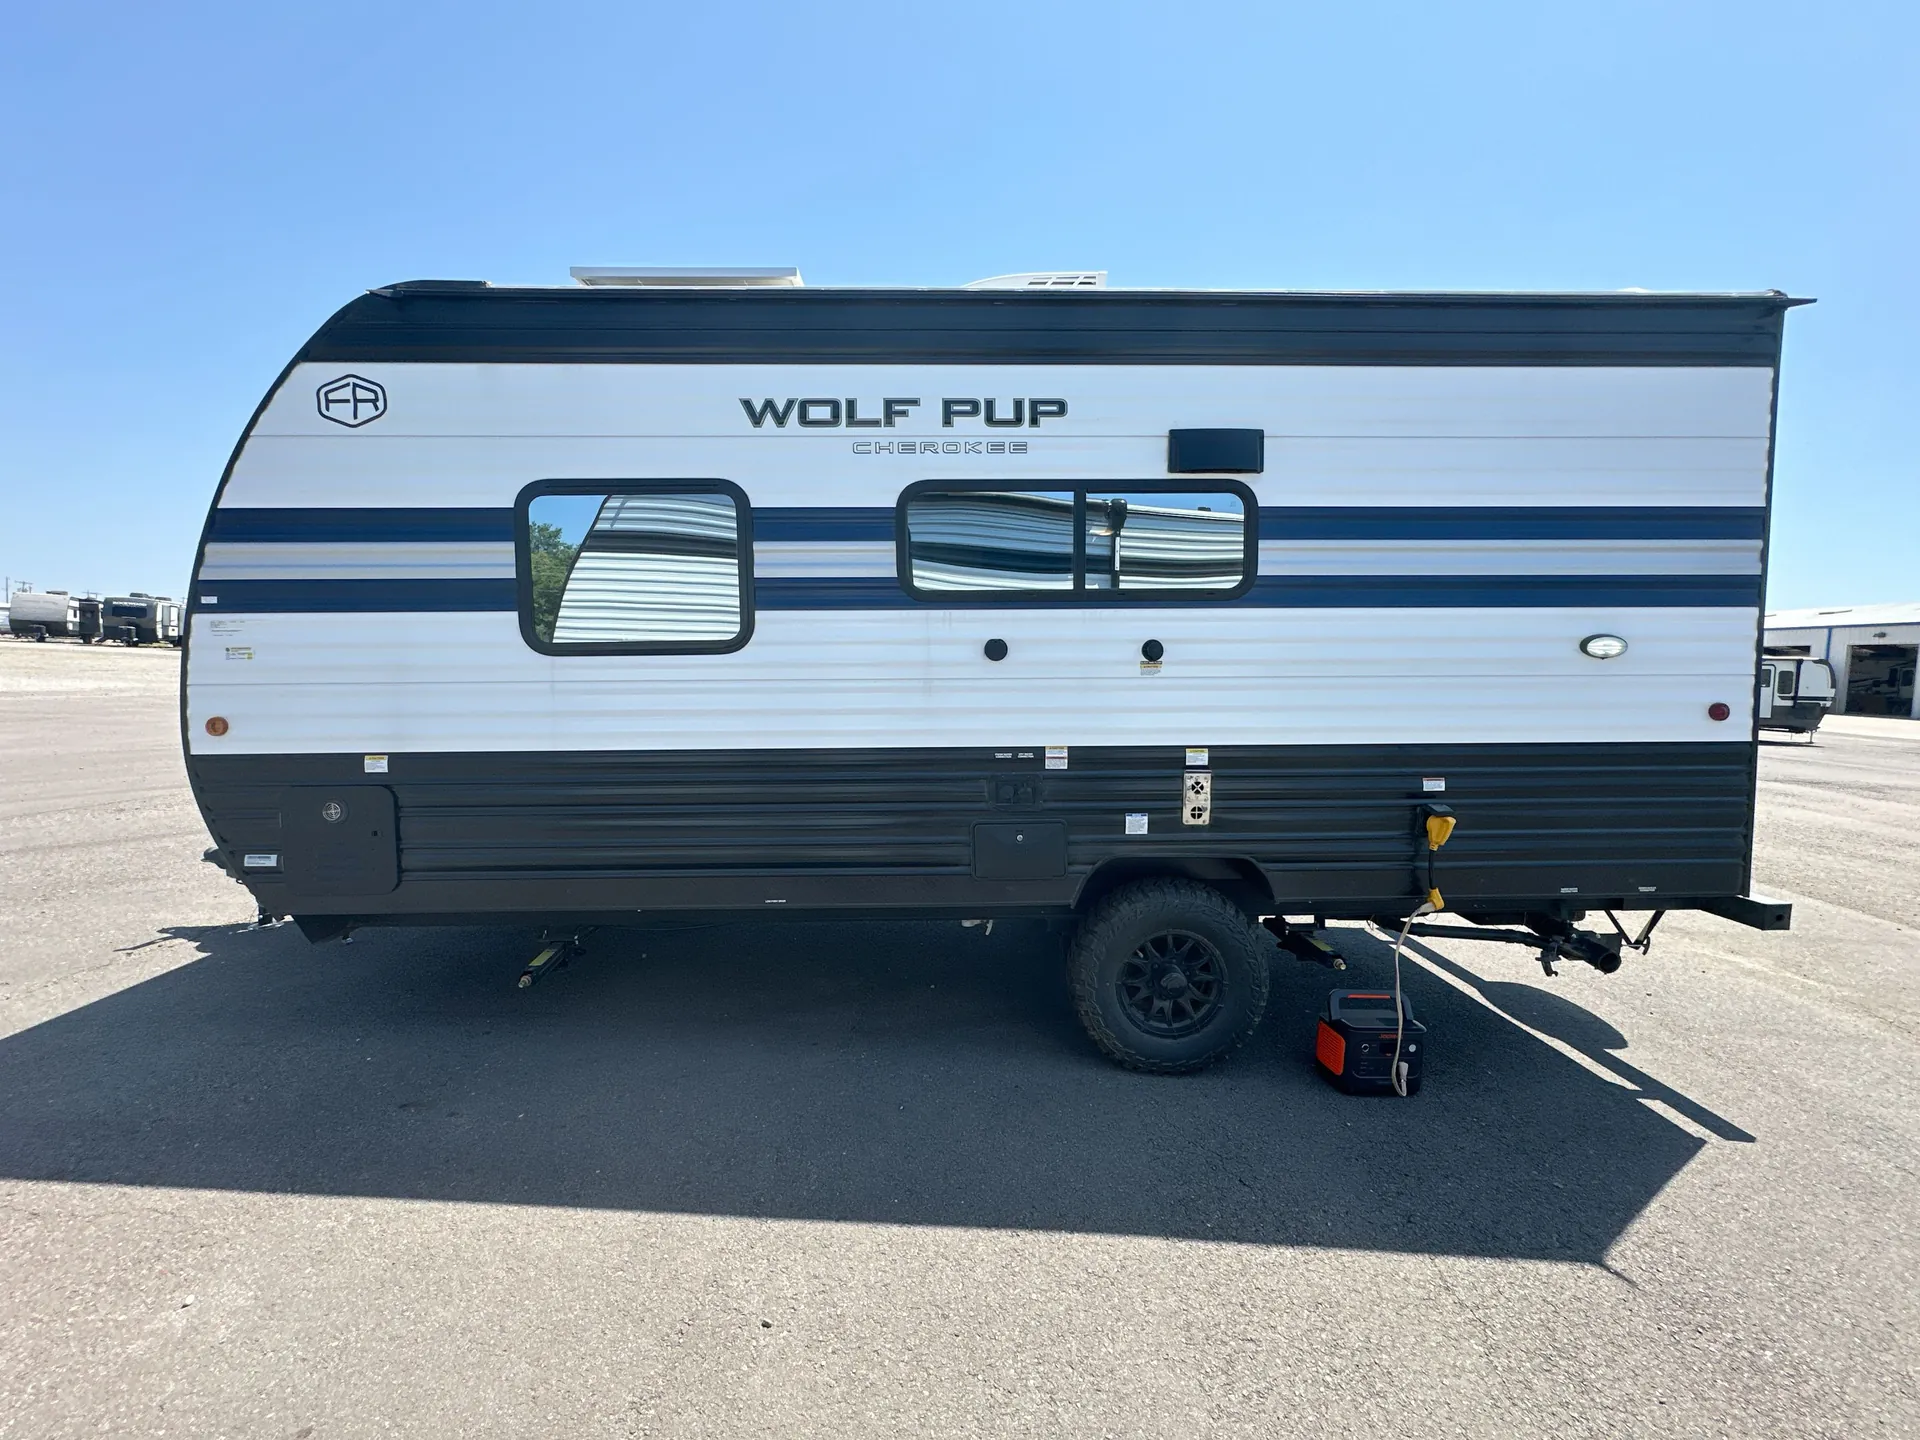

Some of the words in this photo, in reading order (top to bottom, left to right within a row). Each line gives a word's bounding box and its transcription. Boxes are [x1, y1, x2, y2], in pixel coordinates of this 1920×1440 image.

[738, 397, 921, 428] WOLF
[942, 397, 1068, 428] PUP
[852, 441, 1028, 454] CHEROKEE
